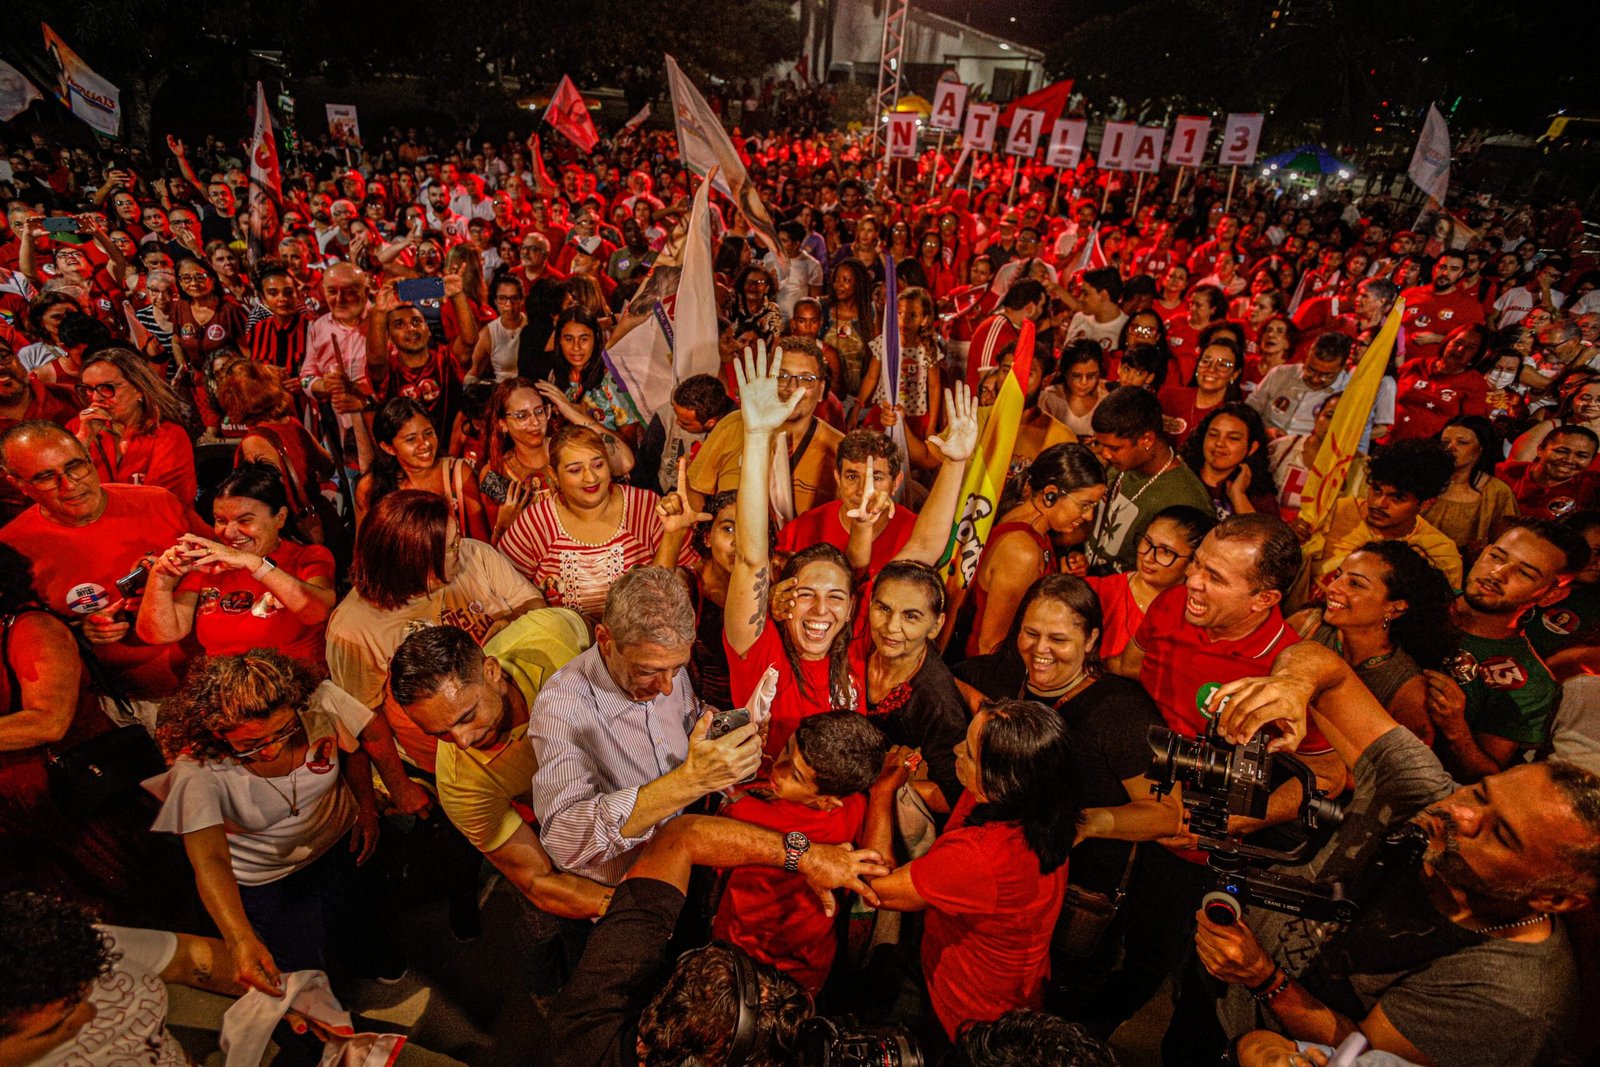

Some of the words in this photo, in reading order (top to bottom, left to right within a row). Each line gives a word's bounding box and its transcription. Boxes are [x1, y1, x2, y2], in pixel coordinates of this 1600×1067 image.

[937, 91, 956, 117] A
[893, 121, 912, 146] N
[973, 113, 991, 138] T
[1013, 113, 1035, 144] Á
[1112, 131, 1124, 158] I
[1134, 135, 1155, 160] A
[1183, 128, 1197, 153] 1
[1230, 126, 1250, 152] 3
[1489, 657, 1524, 685] 13
